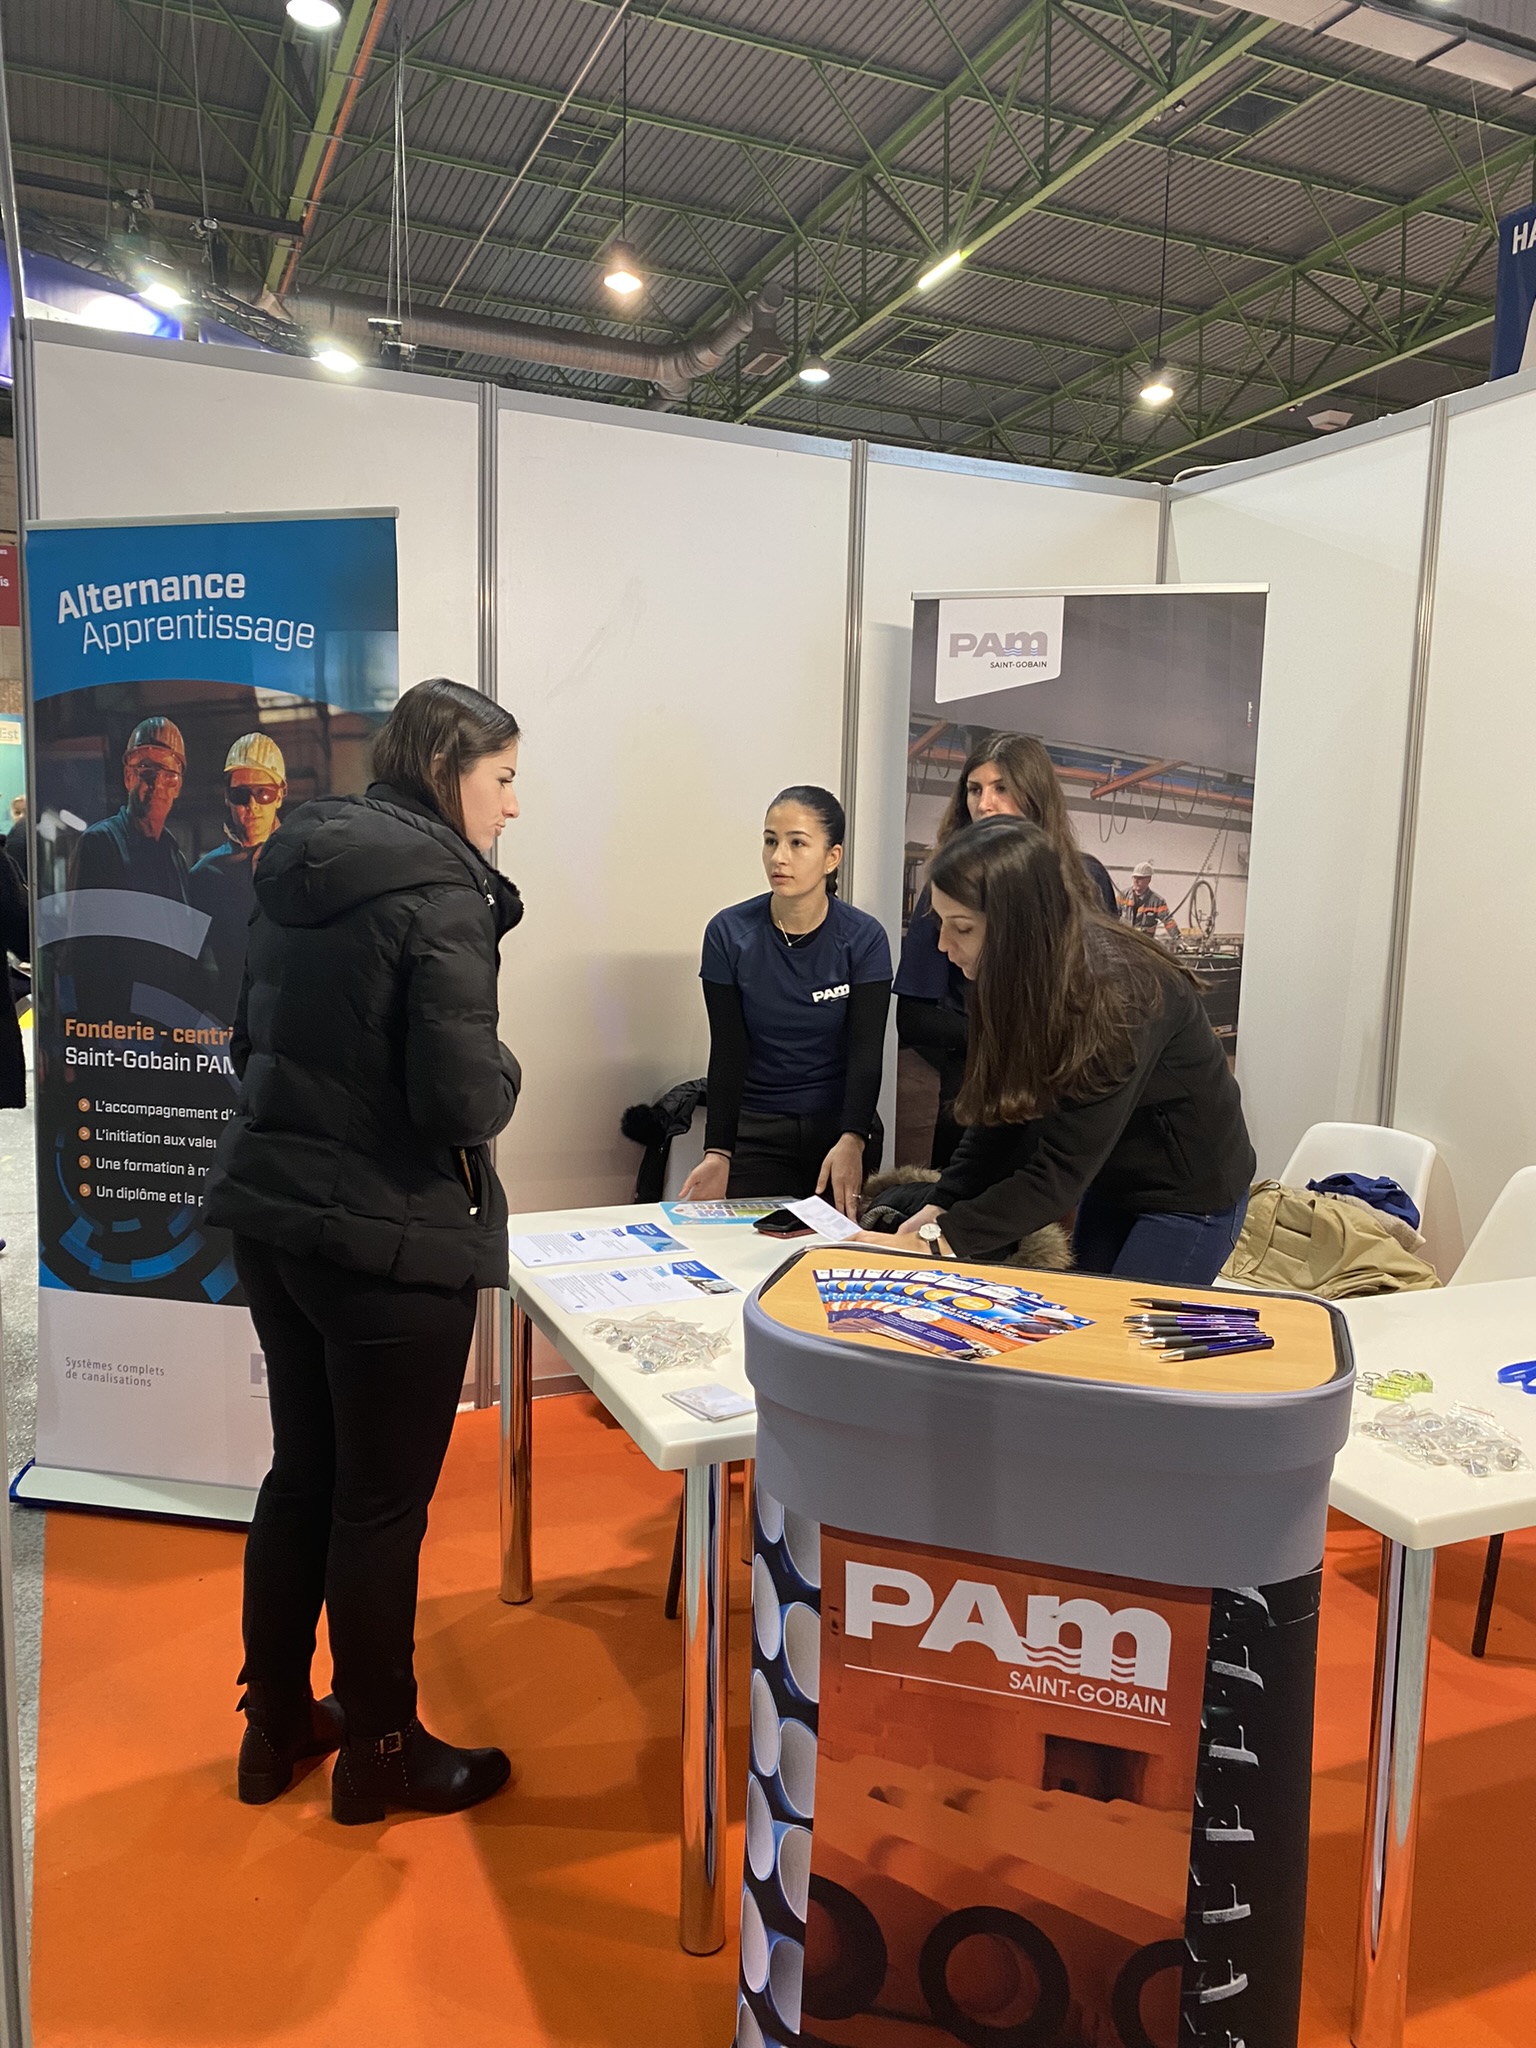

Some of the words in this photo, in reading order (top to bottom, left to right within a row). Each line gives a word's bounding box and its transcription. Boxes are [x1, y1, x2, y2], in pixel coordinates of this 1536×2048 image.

[57, 572, 246, 624] Alternance
[82, 606, 315, 654] Apprentissage
[990, 660, 1048, 669] SAINT-GOBAIN
[65, 1018, 155, 1041] Fonderie
[65, 1047, 191, 1072] Saint-Gobain
[95, 1100, 218, 1120] L'accompagnement
[95, 1128, 161, 1145] L'initiation
[163, 1135, 186, 1147] aux
[96, 1157, 121, 1171] Une
[123, 1158, 185, 1175] formation
[187, 1163, 195, 1176] à
[96, 1185, 113, 1198] Un
[116, 1186, 167, 1203] diplôme
[169, 1190, 182, 1204] et
[184, 1191, 195, 1205] la
[65, 1356, 113, 1372] Systèmes
[117, 1361, 165, 1378] complets
[65, 1369, 78, 1380] de
[81, 1371, 152, 1388] canalisations
[1009, 1670, 1167, 1717] SAINT-GOBAIN
